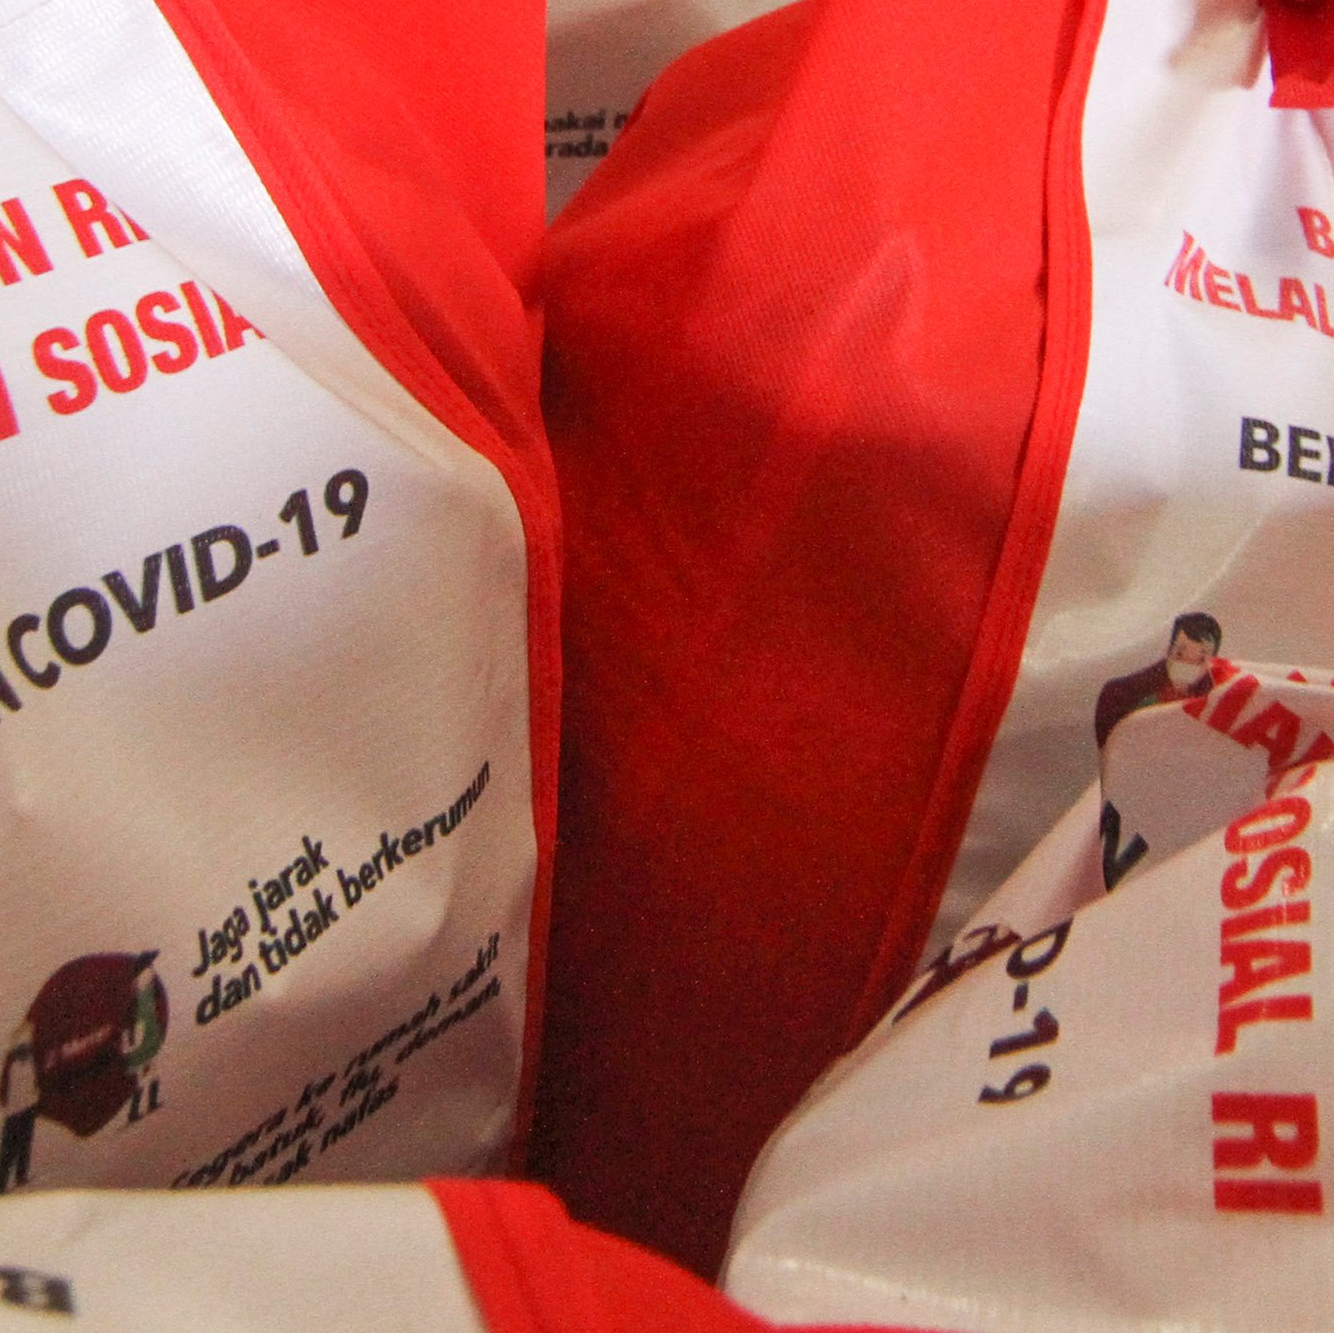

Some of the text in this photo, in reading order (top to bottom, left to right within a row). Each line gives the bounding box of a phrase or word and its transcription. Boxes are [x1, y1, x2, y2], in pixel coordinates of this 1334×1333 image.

[7, 468, 369, 689] COVID-19
[192, 834, 330, 979] Jaga jarak
[196, 963, 262, 1027] dan
[258, 887, 340, 976] tidak
[1210, 1090, 1325, 1216] RI
